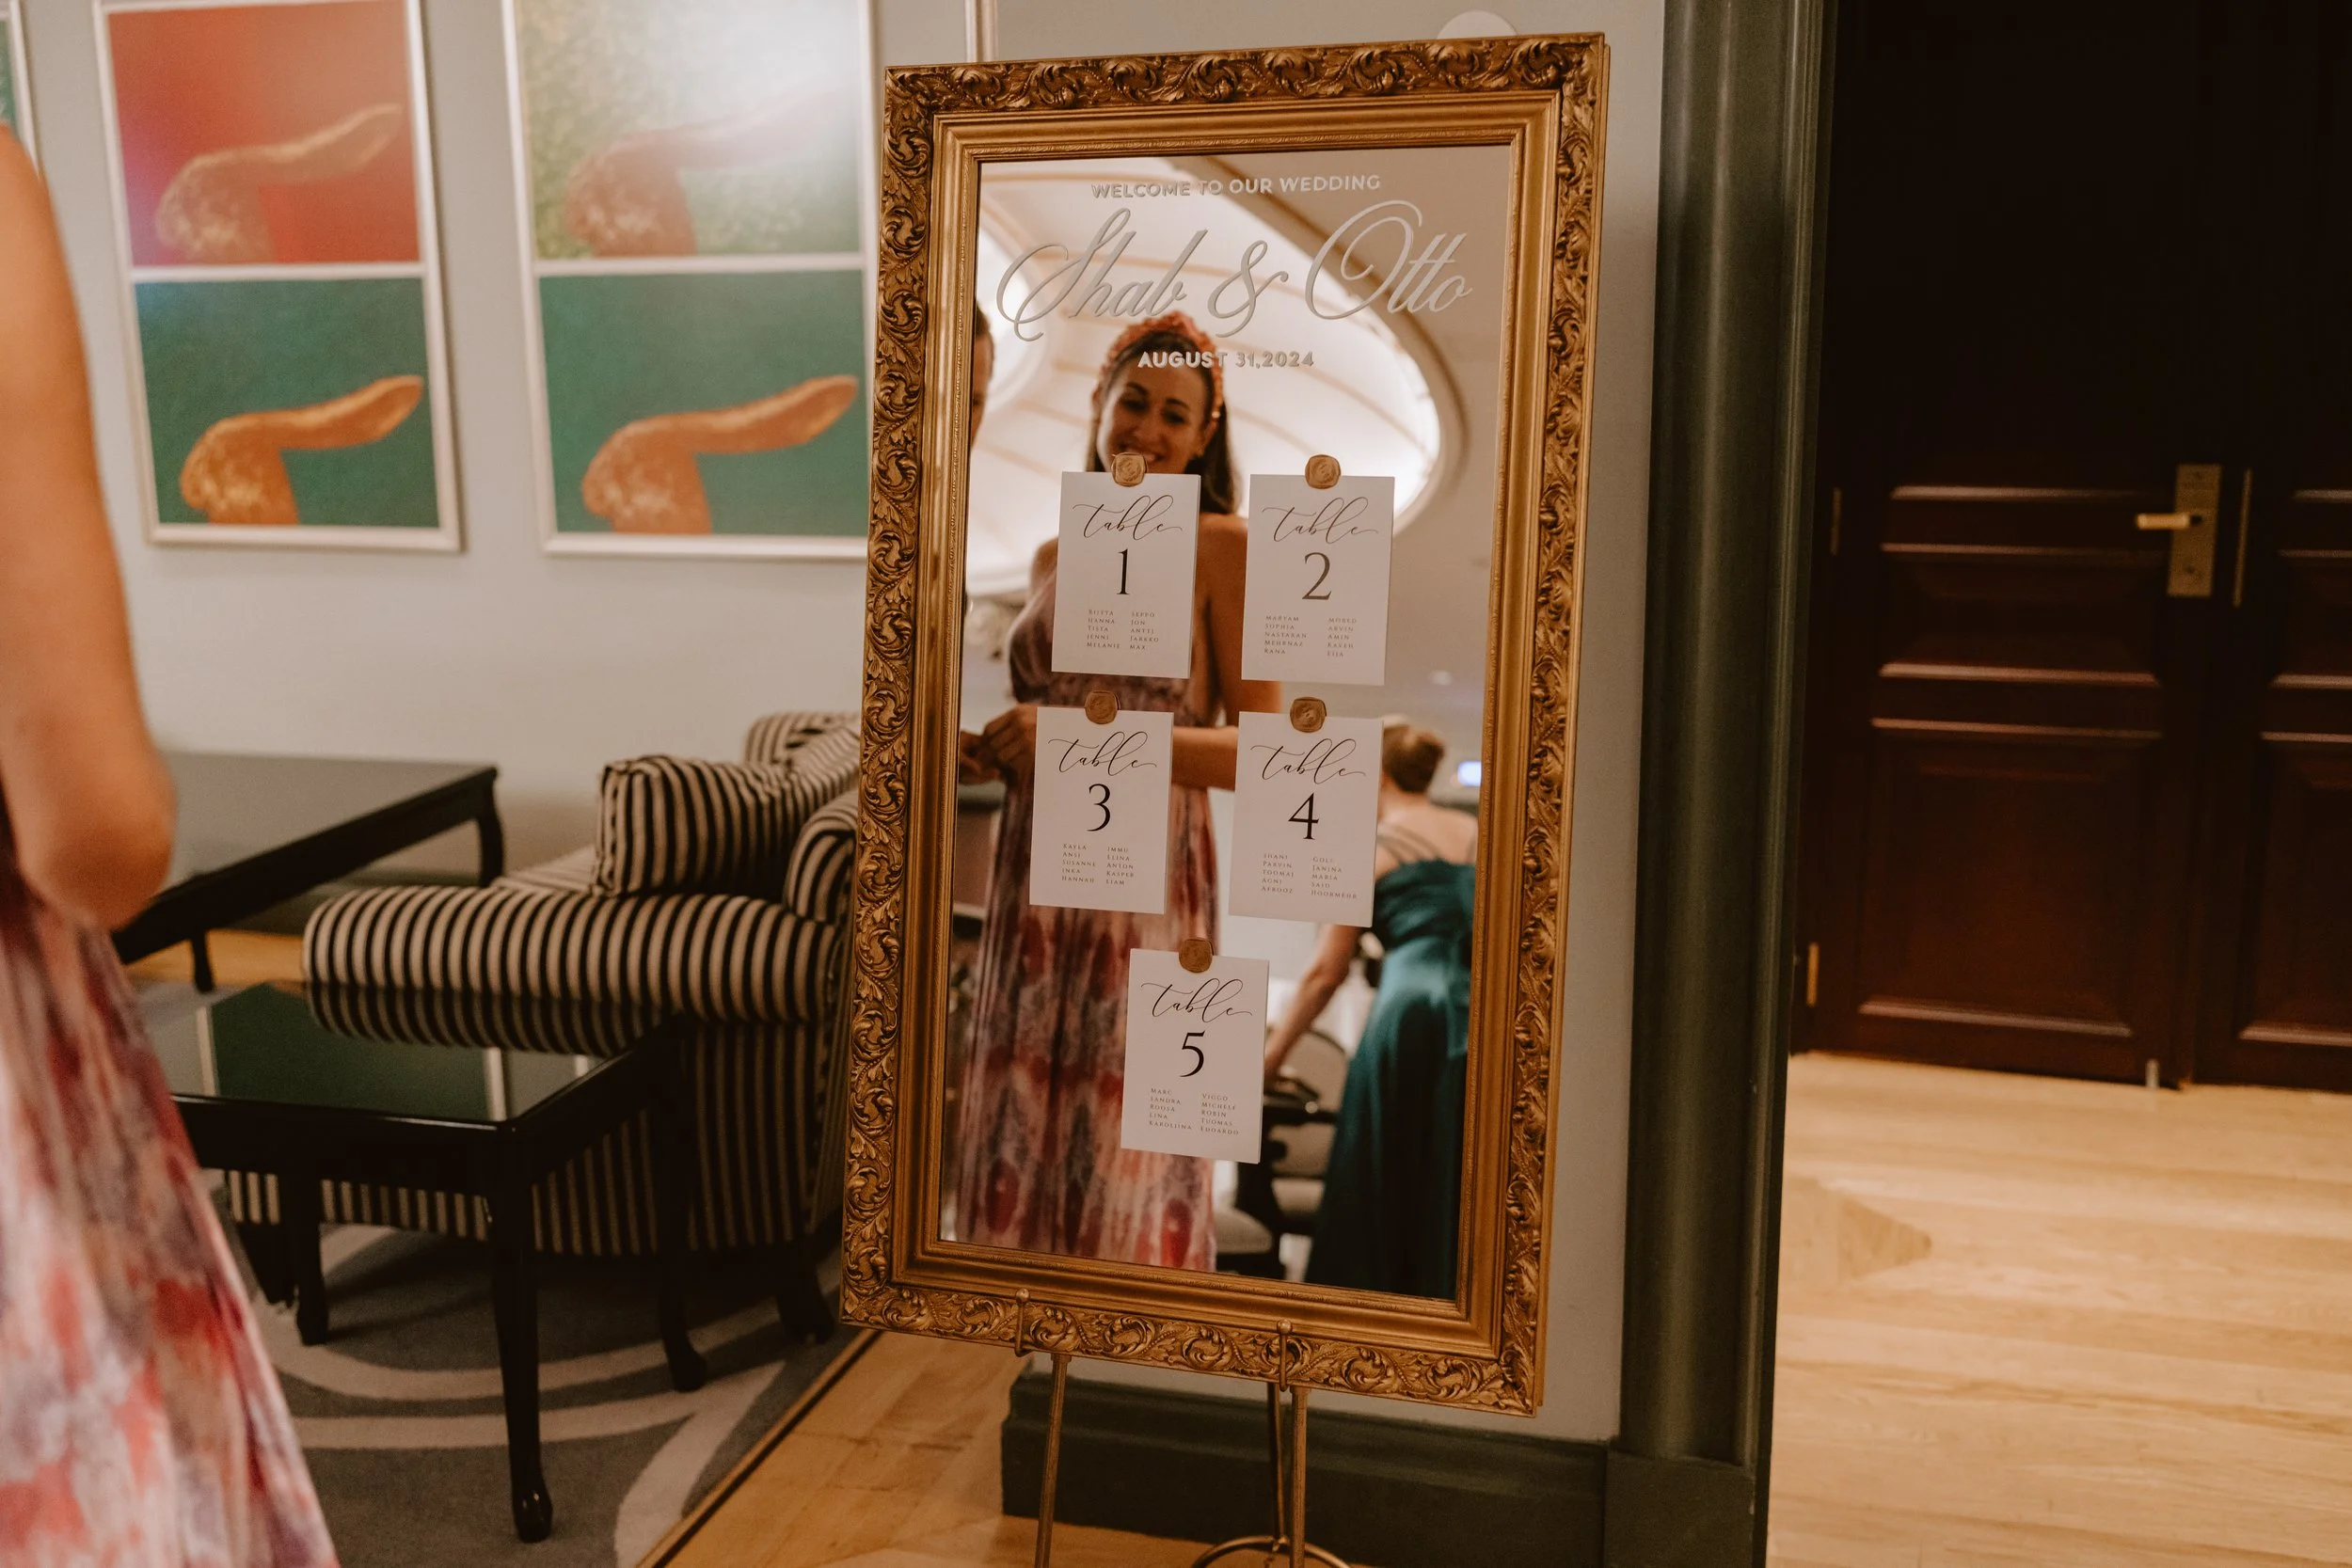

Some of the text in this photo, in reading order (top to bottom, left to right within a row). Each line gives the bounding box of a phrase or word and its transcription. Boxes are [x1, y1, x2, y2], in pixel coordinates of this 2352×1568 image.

[1090, 175, 1381, 198] WELCOME TO OUR WEDDING
[996, 199, 1473, 341] Shab & Otto
[1137, 350, 1315, 369] AUGUST 31,2024
[1072, 495, 1183, 541] table
[1262, 497, 1379, 545] table
[1116, 548, 1130, 595] 1
[1301, 552, 1332, 601] 2
[1048, 731, 1157, 777] table
[1249, 737, 1366, 785] table
[1087, 784, 1112, 832] 3
[1288, 792, 1319, 840] 4
[1061, 875, 1095, 883] HANNAH
[1062, 859, 1095, 867] SUSANNE
[1263, 860, 1293, 869] PARVIN
[1140, 977, 1253, 1023] table
[1179, 1030, 1206, 1078] 5
[1150, 1096, 1181, 1104] SANDRA
[1200, 1109, 1227, 1117] ROBIN
